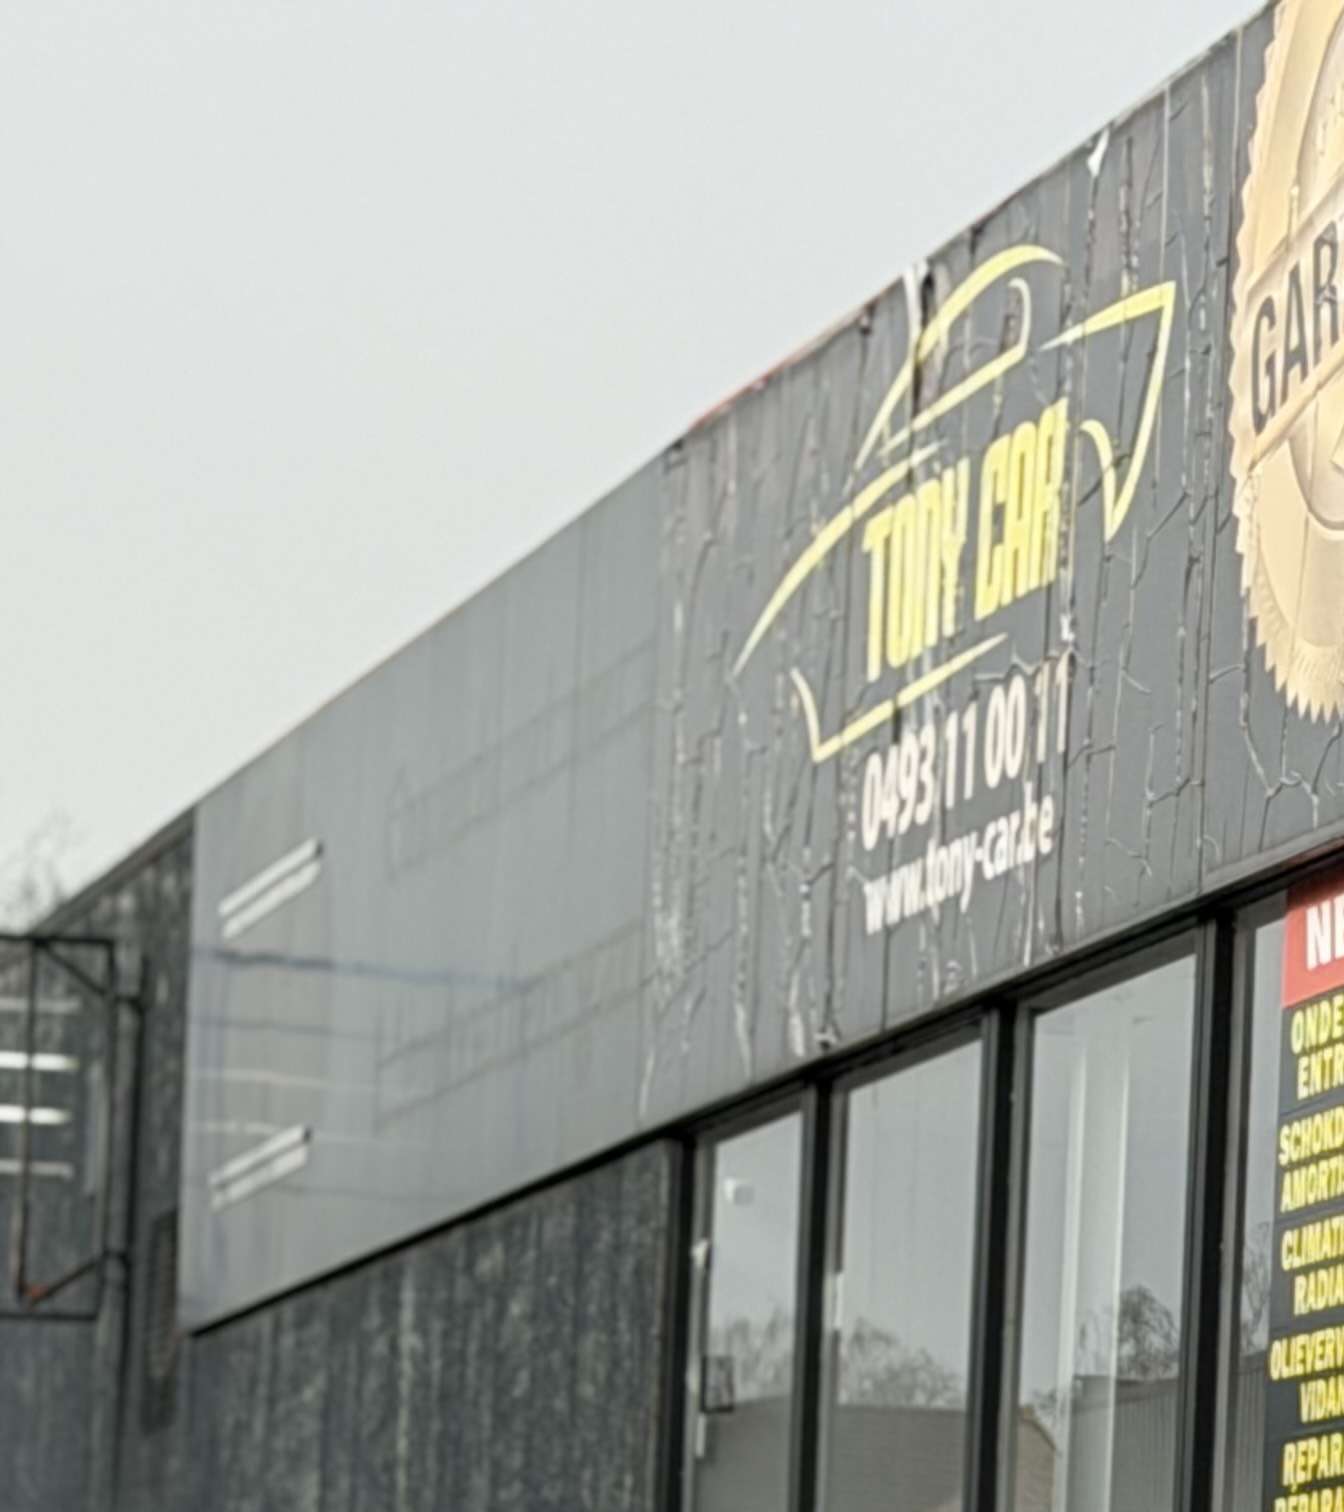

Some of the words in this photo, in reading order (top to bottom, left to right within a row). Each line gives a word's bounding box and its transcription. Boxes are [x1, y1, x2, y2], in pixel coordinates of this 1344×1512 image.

[863, 456, 970, 683] TONY
[975, 397, 1068, 621] CAR
[862, 722, 936, 851] 0493
[945, 702, 978, 811] 11
[983, 674, 1026, 789] 00
[863, 781, 1054, 935] www.tony-car.be
